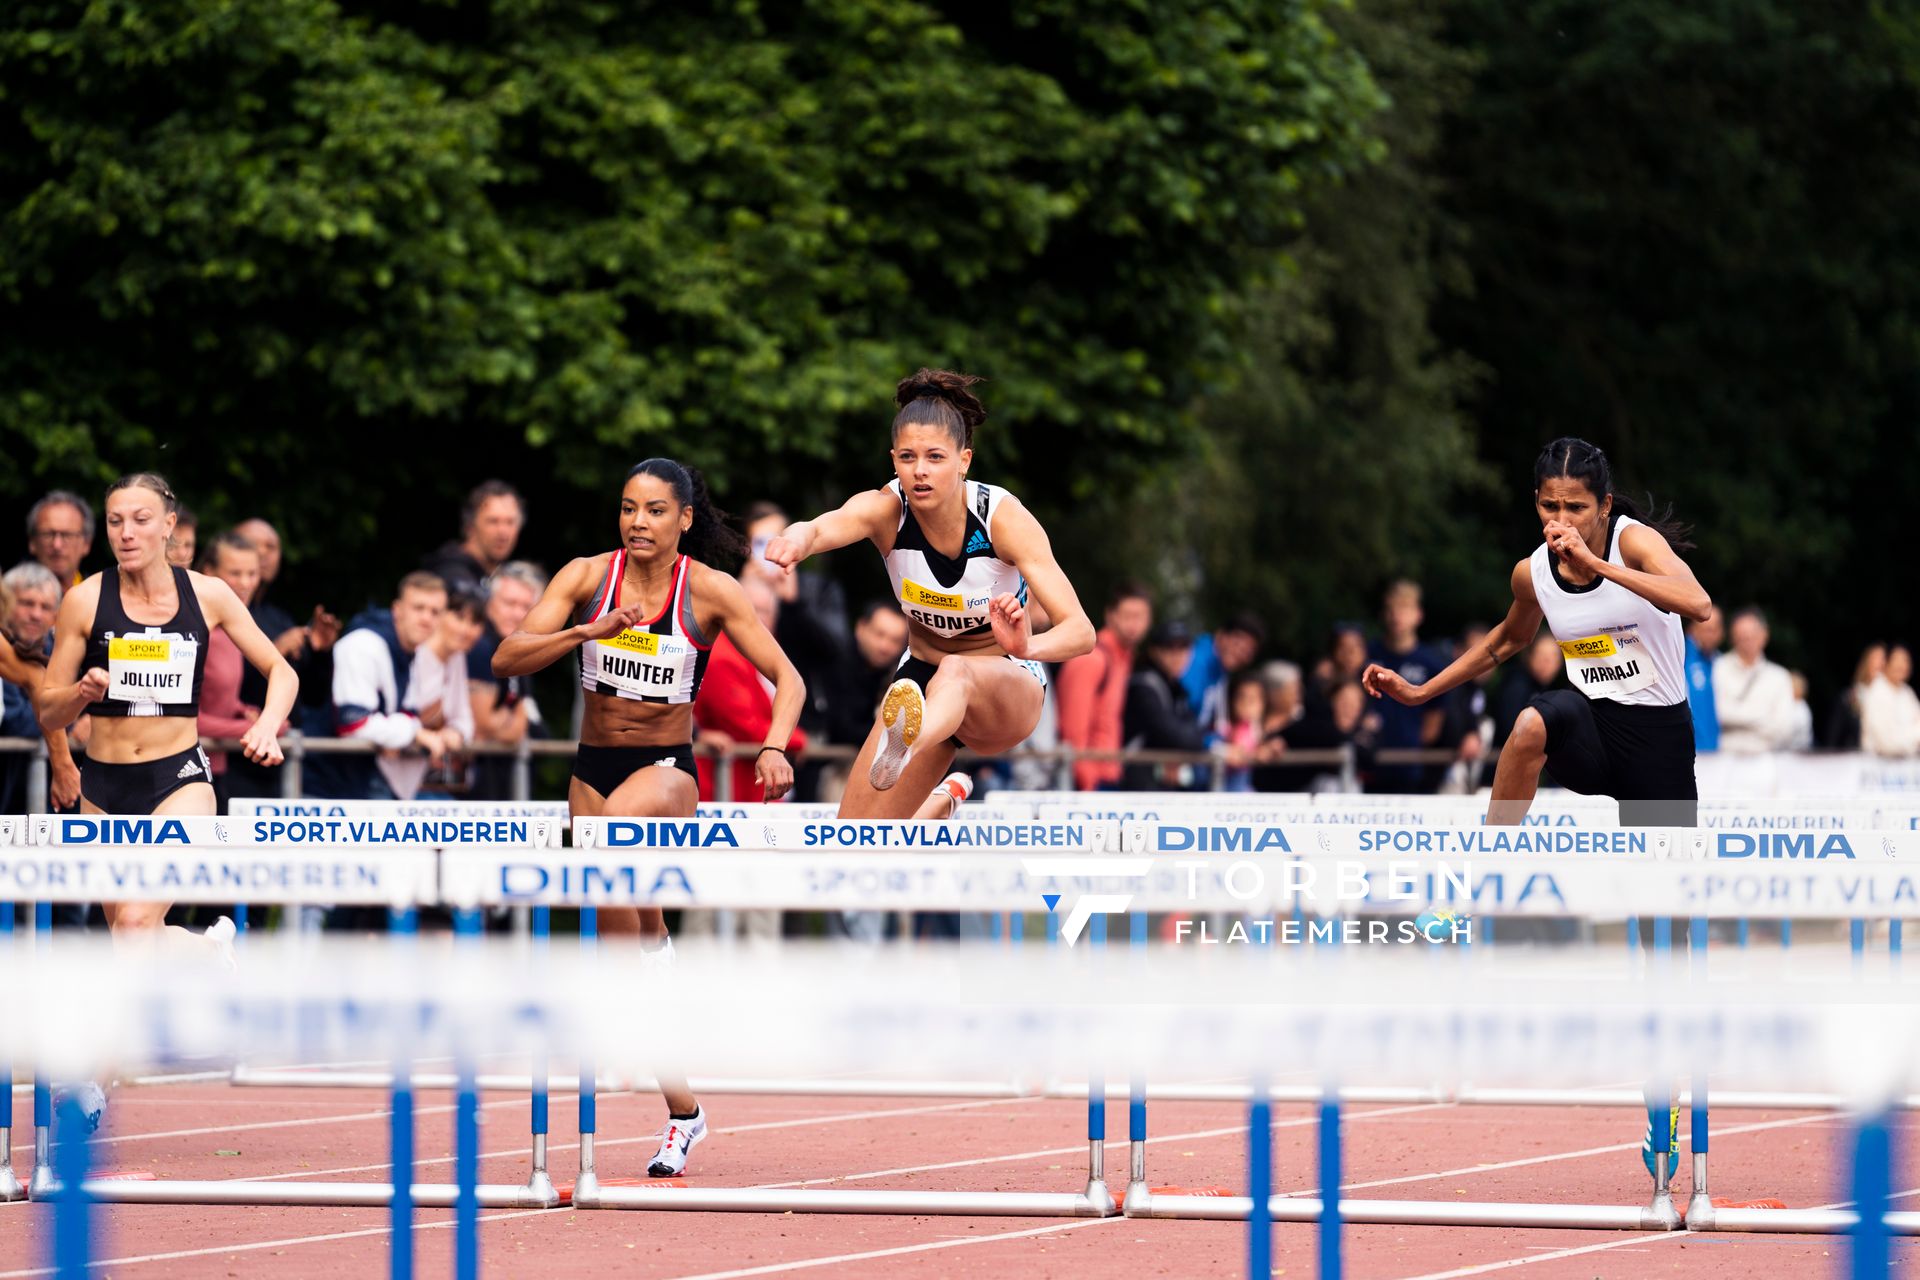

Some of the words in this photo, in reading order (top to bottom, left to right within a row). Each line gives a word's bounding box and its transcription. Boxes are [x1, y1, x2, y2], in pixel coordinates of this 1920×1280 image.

[966, 542, 990, 553] adidas
[919, 590, 958, 604] SPORT.
[967, 597, 990, 609] ifam
[910, 609, 986, 630] SEDNEY
[616, 640, 653, 652] VLAANDEREN
[617, 632, 653, 647] SPORT.
[1574, 640, 1609, 652] SPORT.
[129, 644, 165, 653] SPORT.
[661, 643, 684, 655] ifam
[602, 654, 675, 685] HUNTER
[1580, 659, 1641, 684] YARRAJI
[120, 671, 182, 688] JOLLIVET
[62, 819, 191, 844] DIMA
[254, 820, 528, 843] SPORT.VLAANDEREN
[607, 822, 740, 847] DIMA
[803, 824, 1084, 848] SPORT.VLAANDEREN
[1157, 826, 1293, 852] DIMA
[1358, 829, 1646, 853] SPORT.VLAANDEREN
[1717, 833, 1857, 859] DIMA
[500, 863, 695, 896] DIMA
